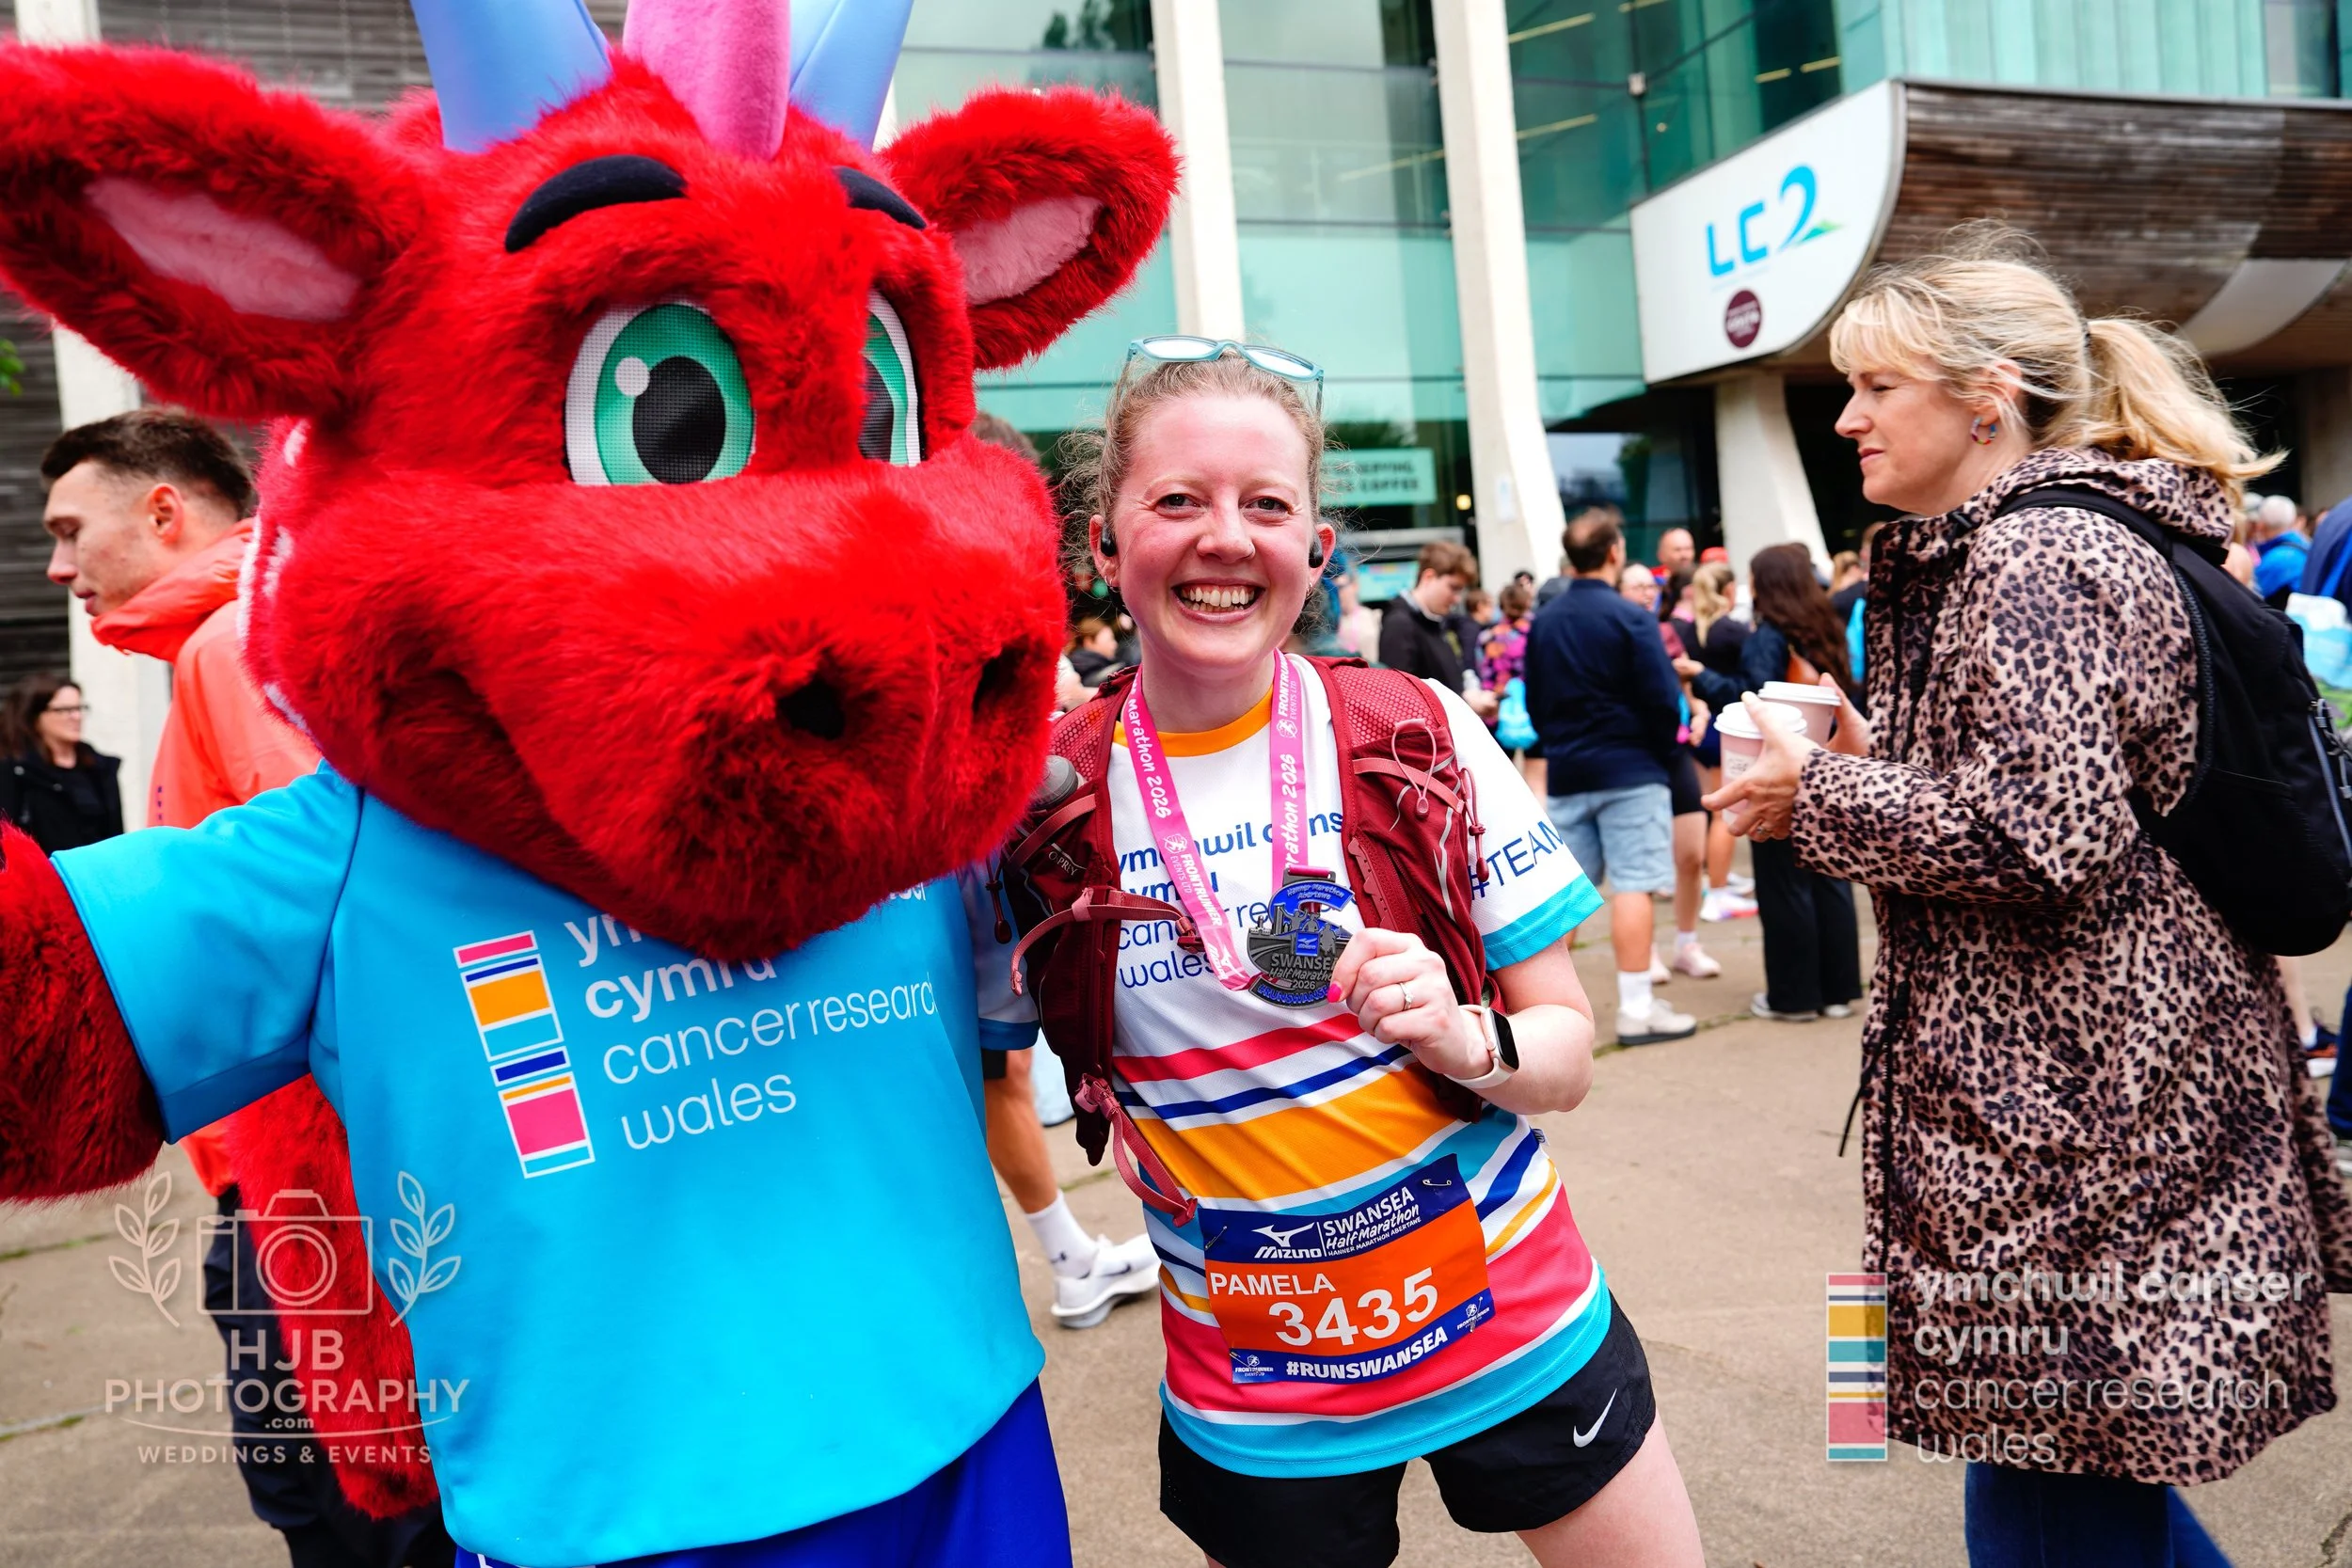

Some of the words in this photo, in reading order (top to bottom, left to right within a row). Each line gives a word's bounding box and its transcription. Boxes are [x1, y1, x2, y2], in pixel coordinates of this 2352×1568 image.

[1706, 165, 1818, 277] LC2
[1289, 692, 1297, 721] EVENTS
[1146, 775, 1172, 819] 2026
[1281, 752, 1298, 799] 2026
[1280, 800, 1299, 869] rathon
[1169, 855, 1187, 881] EVENTS
[1181, 881, 1193, 894] LTD
[1180, 853, 1223, 927] FRONTRUNNER
[1257, 983, 1329, 1004] #RUNSWANSE
[1293, 980, 1316, 989] 2026
[603, 1002, 801, 1085] cancer
[621, 1073, 797, 1150] wales
[1323, 1186, 1415, 1237] SWANSEA
[1327, 1245, 1356, 1257] HANNER
[1356, 1232, 1391, 1251] MARATHON
[1391, 1217, 1422, 1236] ABERTAWE
[1210, 1273, 1337, 1296] PAMELA
[1268, 1267, 1439, 1348] 3435
[1286, 1326, 1448, 1380] #RUNSWANSEA
